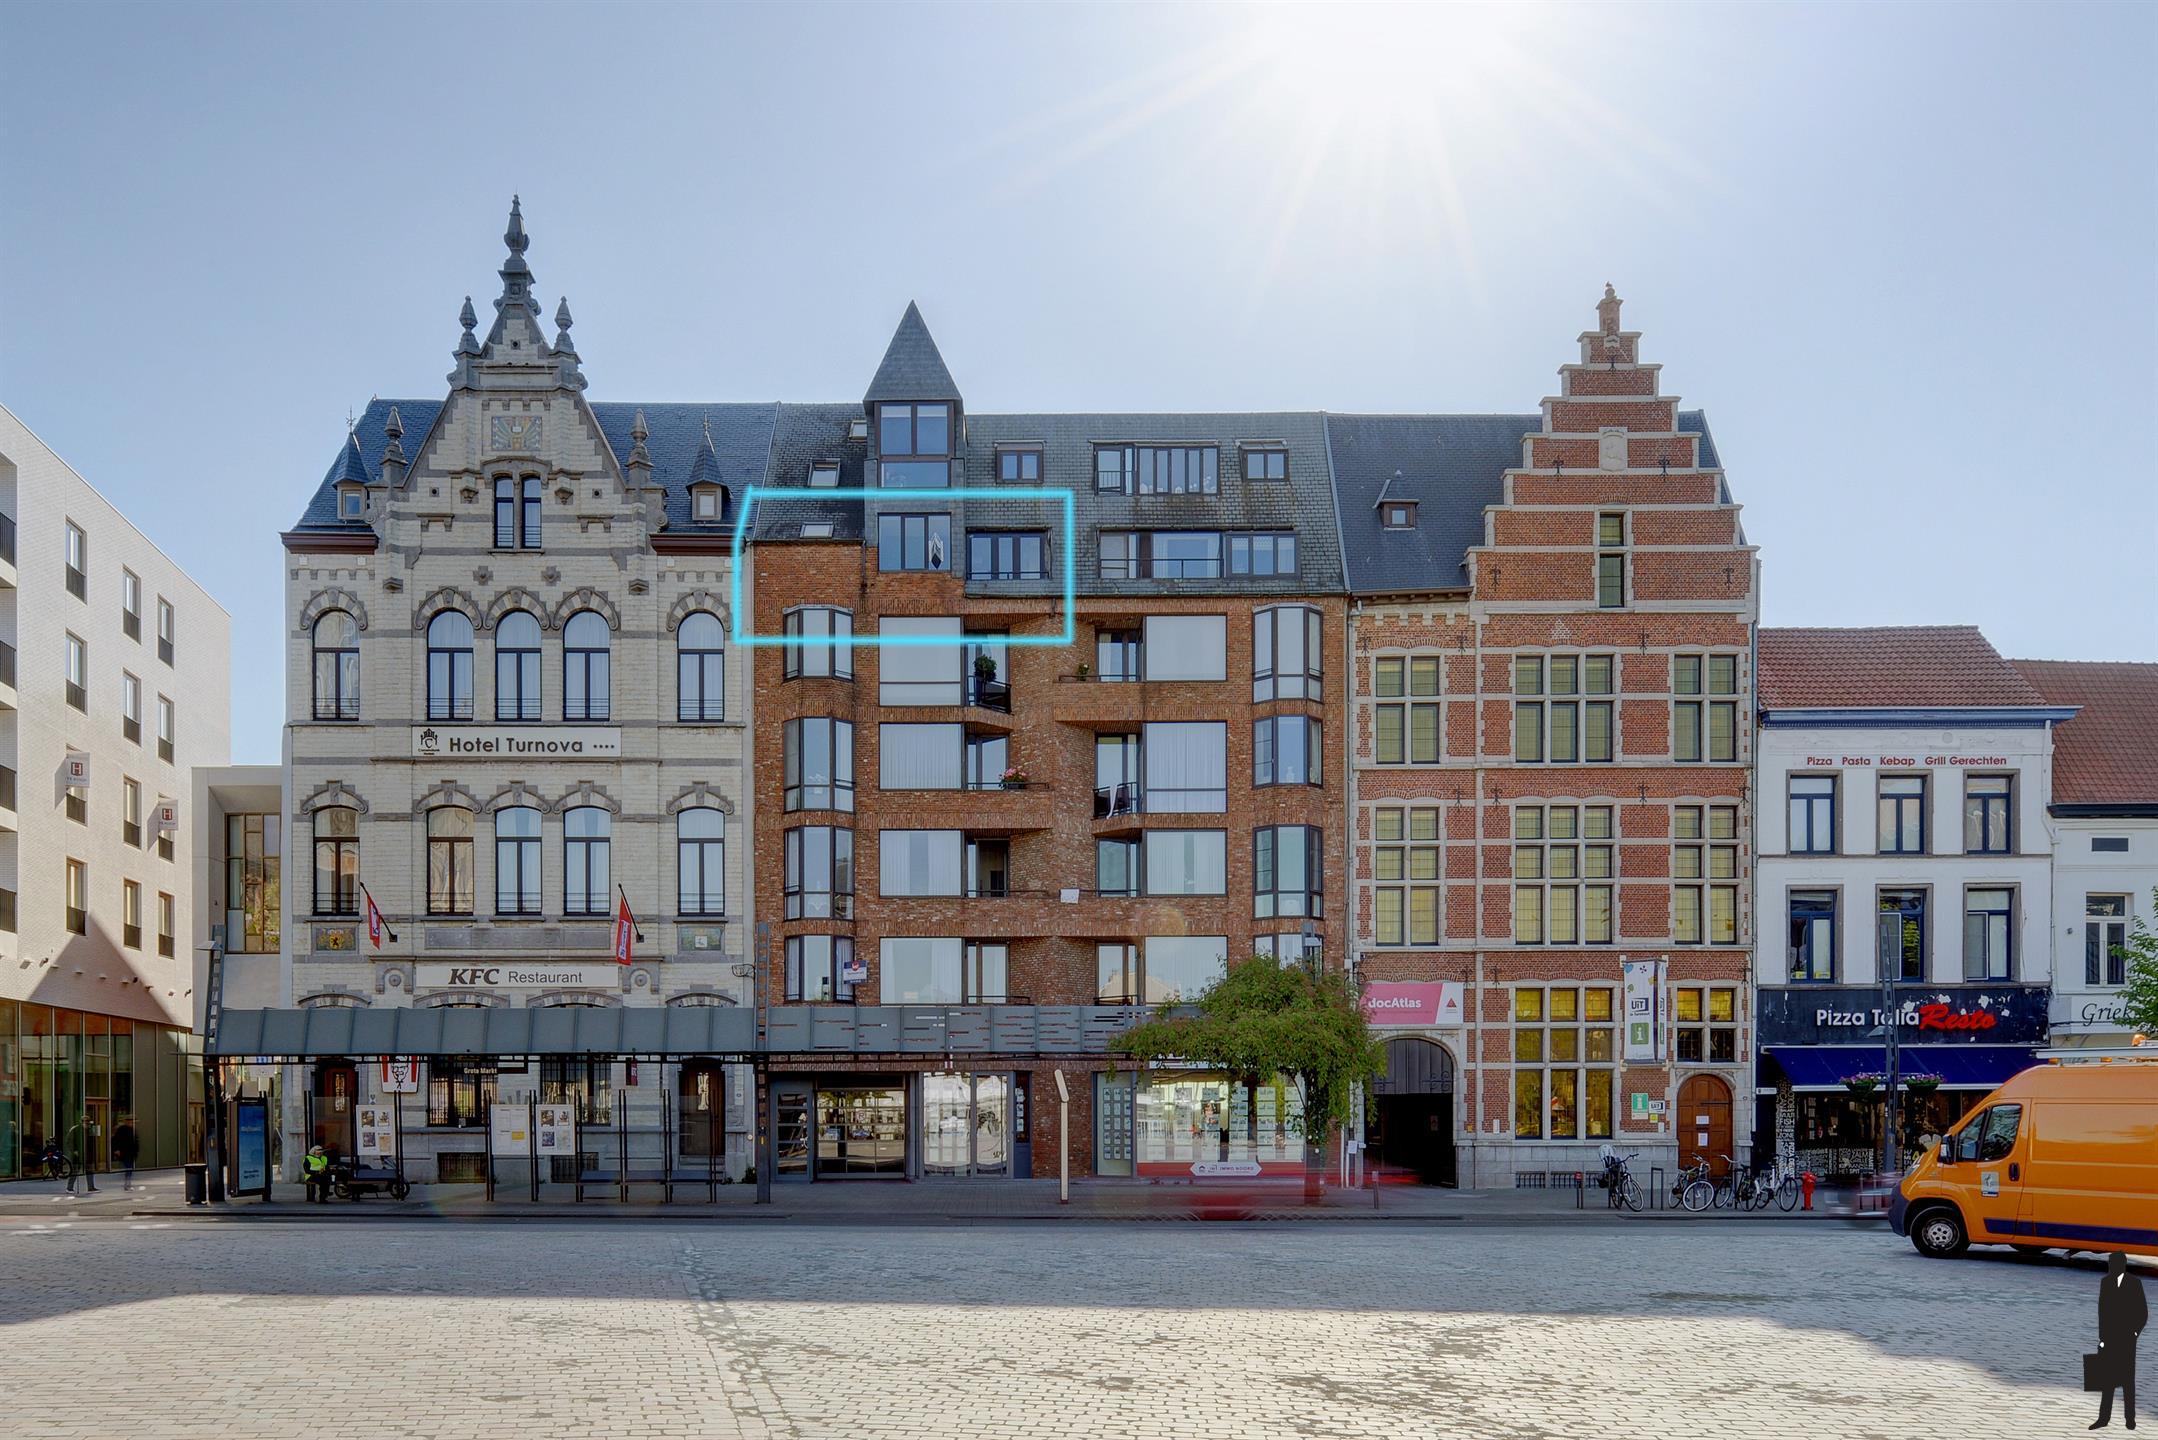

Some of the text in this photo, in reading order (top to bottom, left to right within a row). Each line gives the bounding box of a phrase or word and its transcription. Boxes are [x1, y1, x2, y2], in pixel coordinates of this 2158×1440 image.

[449, 737, 499, 752] Hotel
[506, 738, 583, 752] Turnova
[1807, 756, 2007, 767] Pizza Pasta Kebap Grill Gerechten
[448, 968, 582, 985] KFC Restaurant
[1368, 997, 1422, 1009] docAtlas
[1816, 1009, 1865, 1026] Pizza
[1919, 1004, 1997, 1030] Resto
